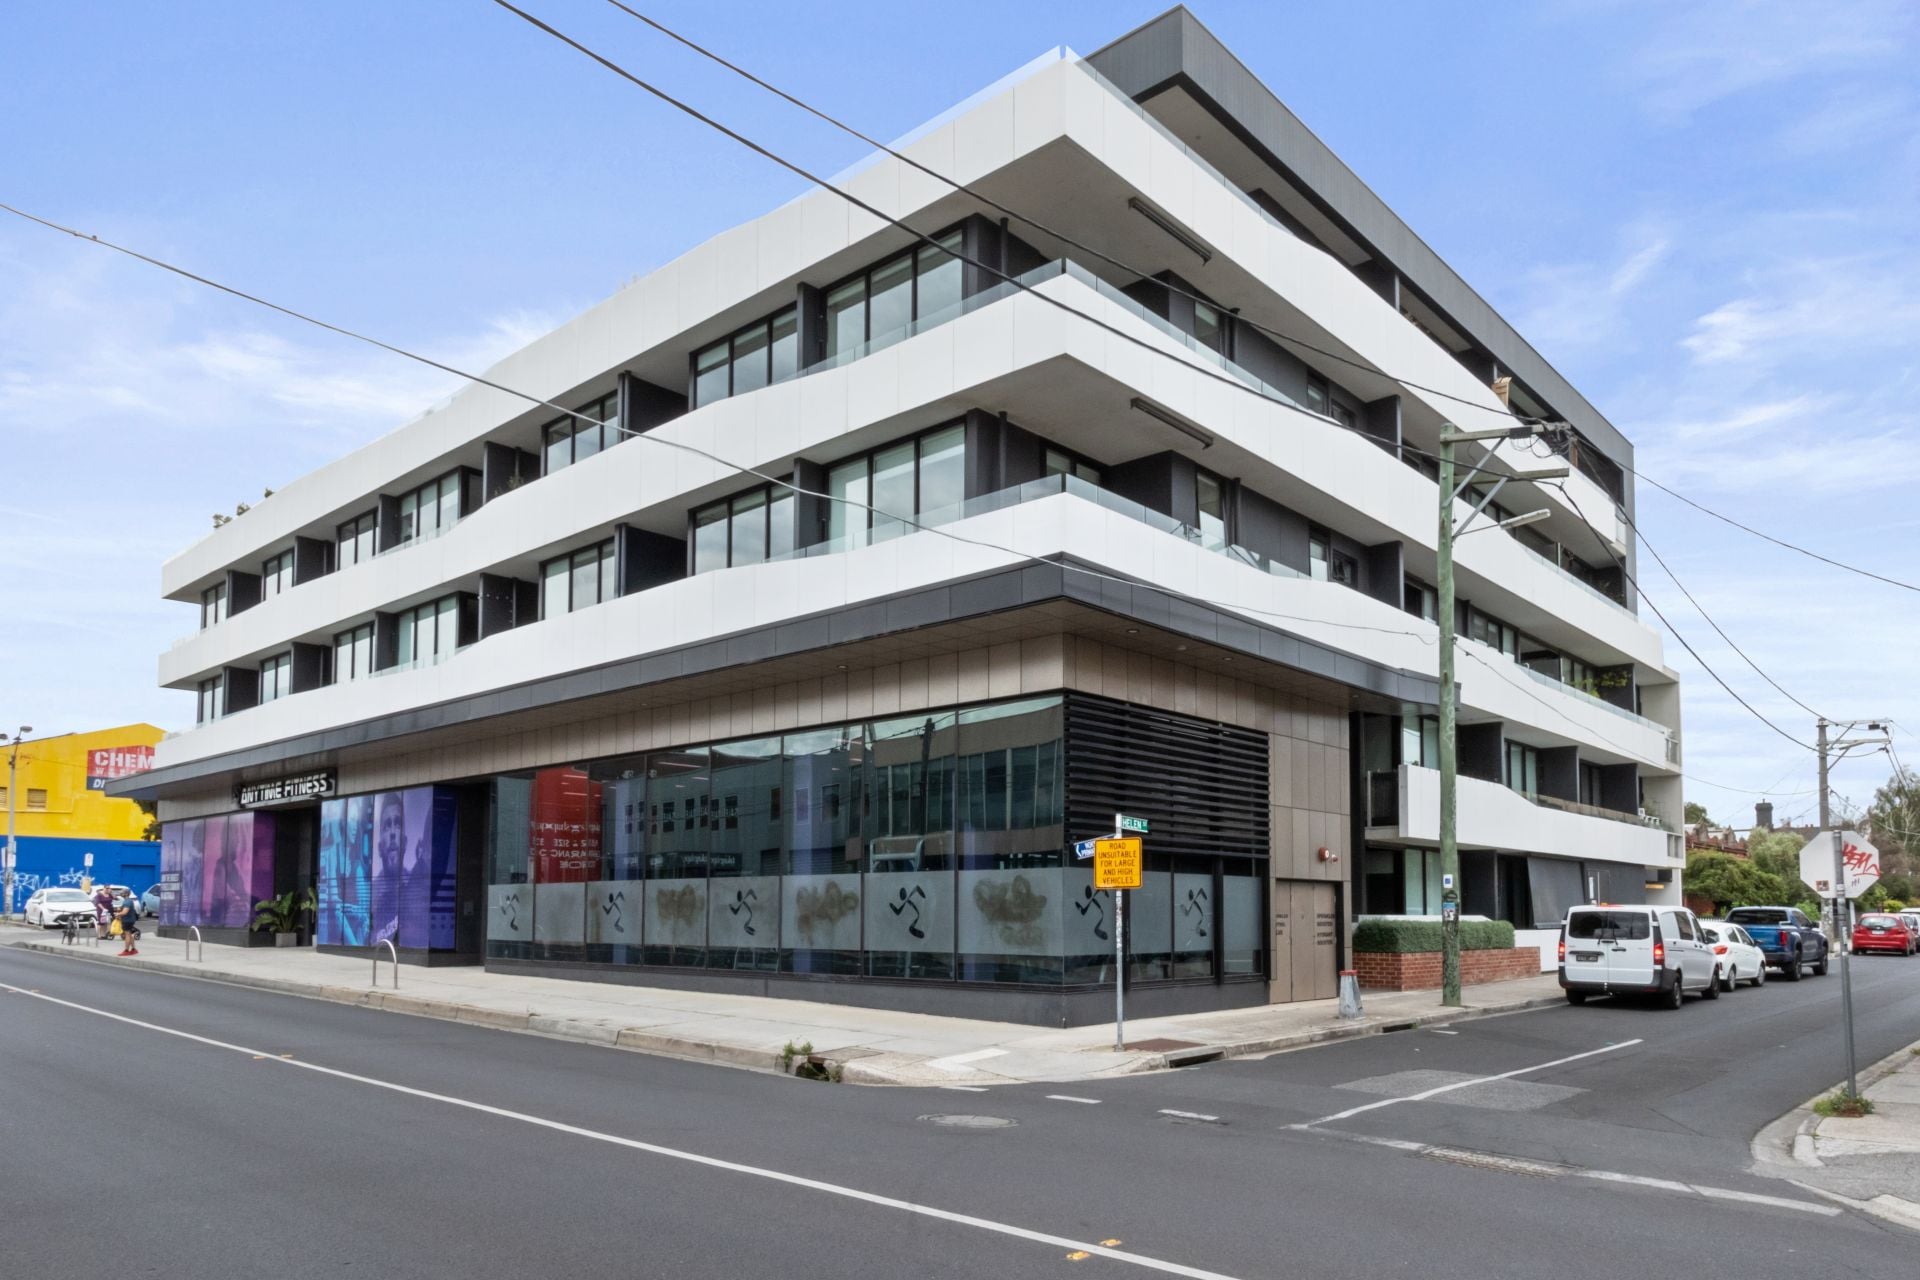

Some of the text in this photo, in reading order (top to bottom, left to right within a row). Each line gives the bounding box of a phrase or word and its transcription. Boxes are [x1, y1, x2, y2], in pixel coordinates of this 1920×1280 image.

[95, 751, 154, 769] CHEM
[241, 773, 327, 804] ANYTIME FITNESS
[1122, 817, 1142, 831] HELEN
[1109, 842, 1126, 850] ROAD
[1098, 850, 1137, 859] UNSUITABLE
[1100, 859, 1135, 868] FOR LARGE
[1103, 867, 1133, 876] AND HIGH
[1102, 876, 1134, 885] VEHICLES
